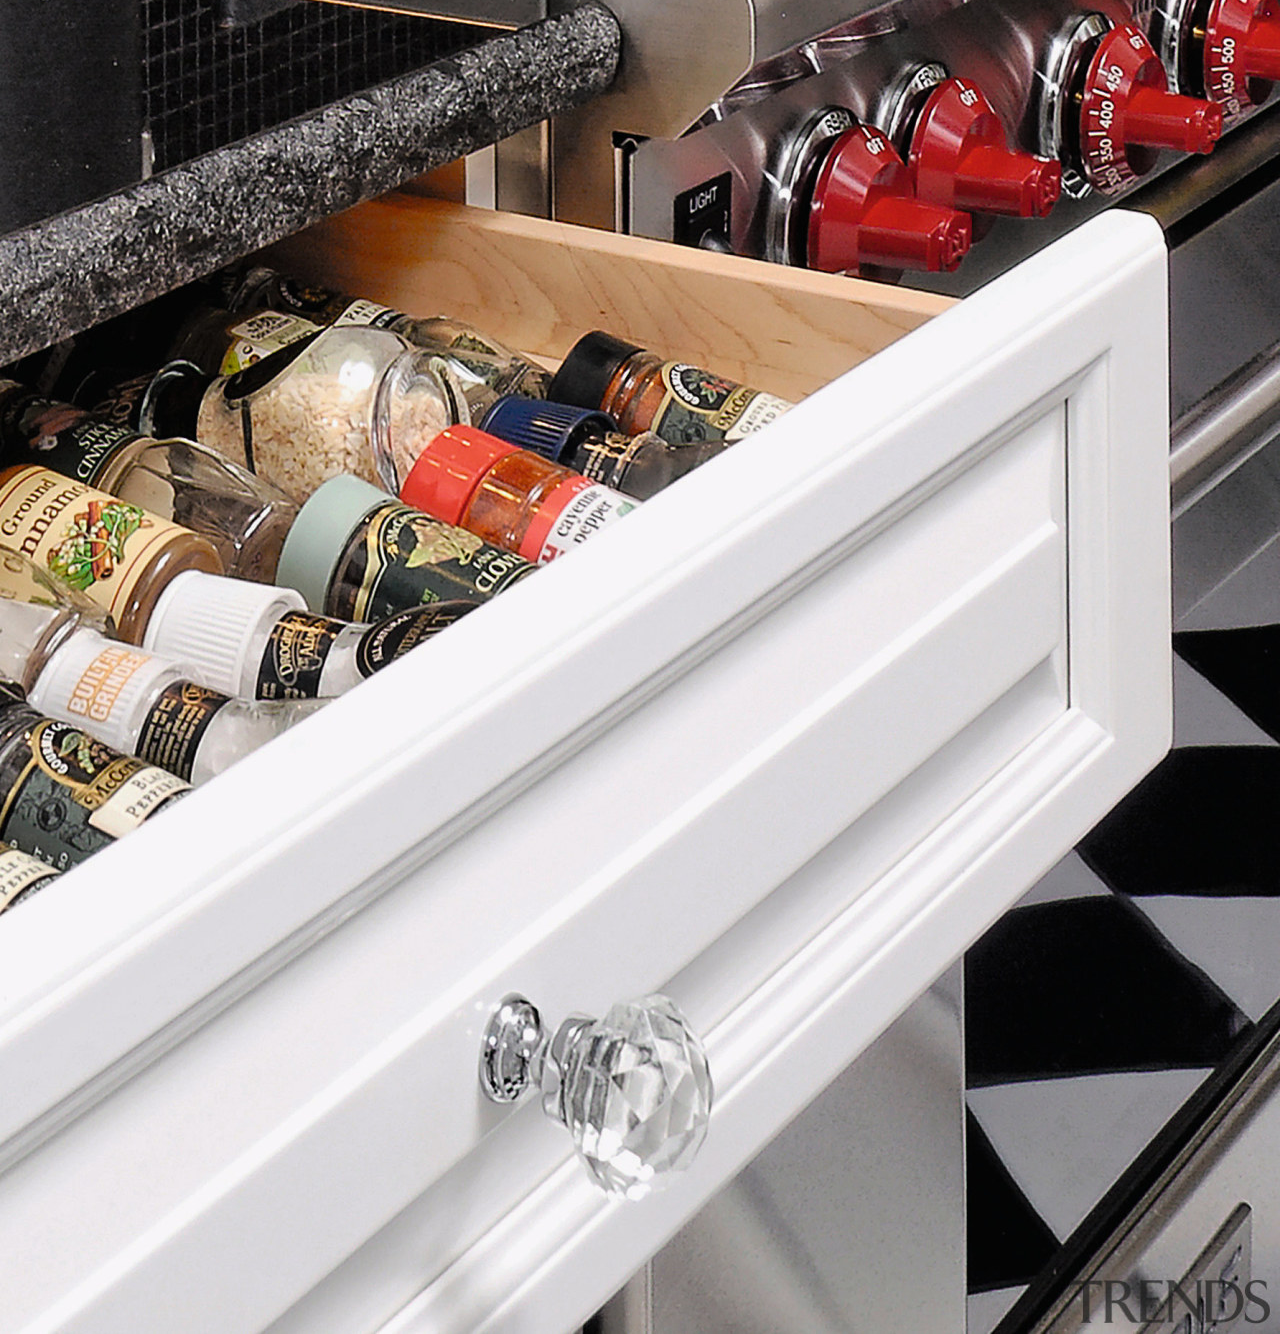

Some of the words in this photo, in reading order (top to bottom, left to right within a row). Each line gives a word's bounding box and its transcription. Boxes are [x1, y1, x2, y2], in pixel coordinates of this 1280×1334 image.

[1221, 37, 1236, 64] 500
[1106, 65, 1124, 93] 450
[1221, 72, 1235, 94] 450
[1099, 100, 1115, 129] 400
[1100, 138, 1114, 164] 350
[688, 185, 718, 214] LIGHT
[0, 478, 58, 537] Ground
[556, 490, 603, 538] cayenne
